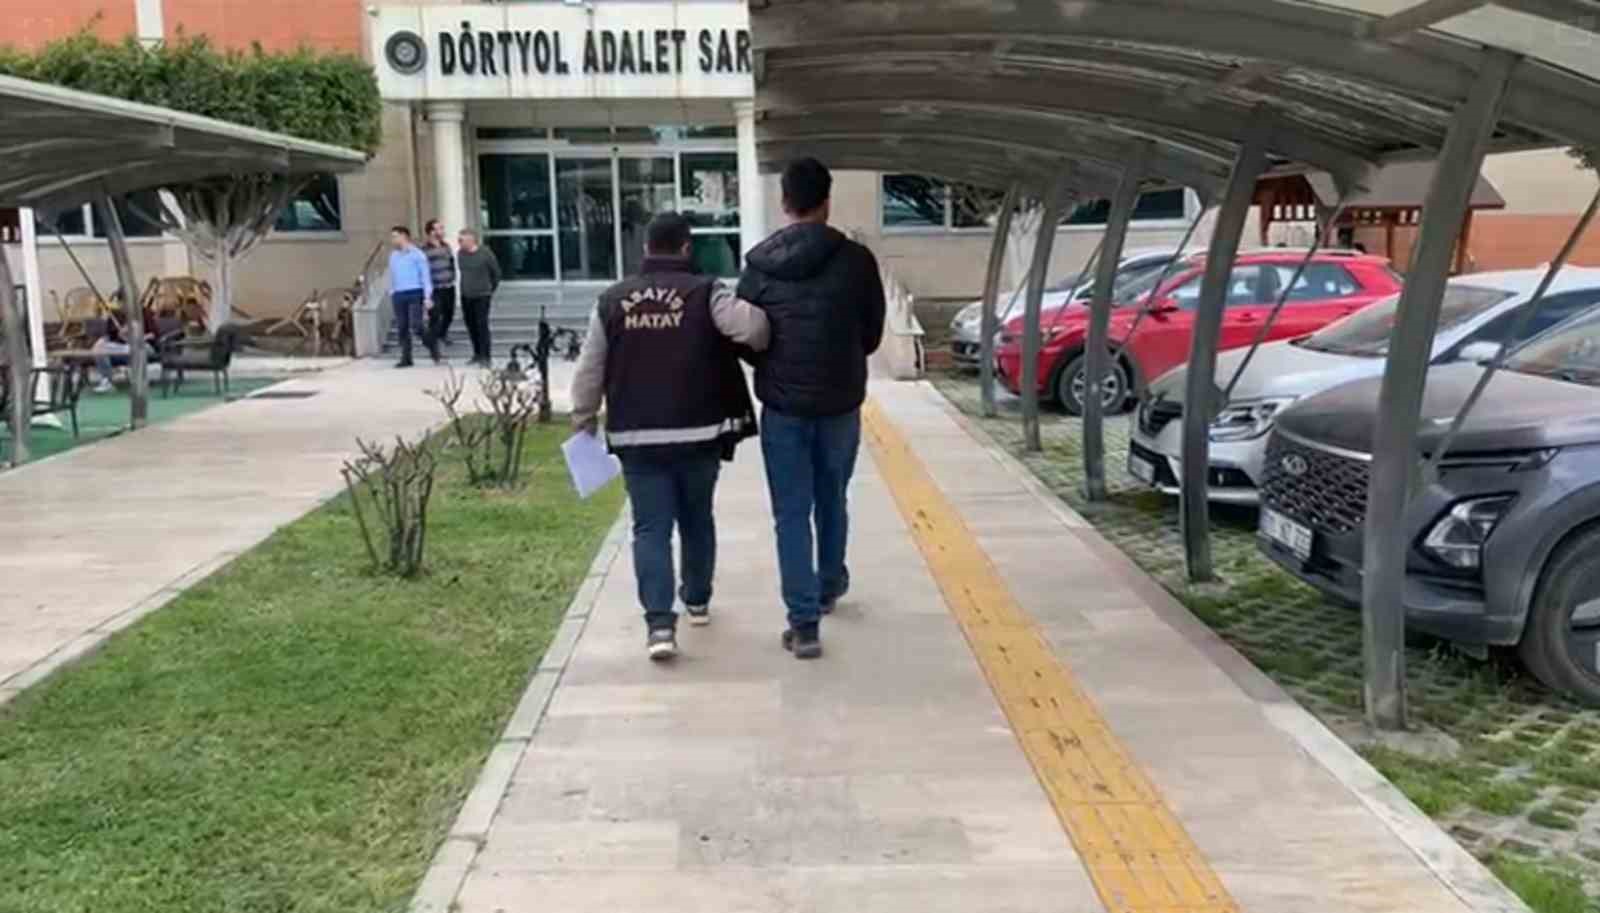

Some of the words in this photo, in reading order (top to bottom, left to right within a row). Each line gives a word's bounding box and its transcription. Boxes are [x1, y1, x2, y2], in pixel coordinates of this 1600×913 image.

[439, 21, 569, 76] DÖRTYOL
[583, 29, 686, 74] ADALET
[698, 29, 752, 74] SAR
[625, 311, 684, 329] HATAY
